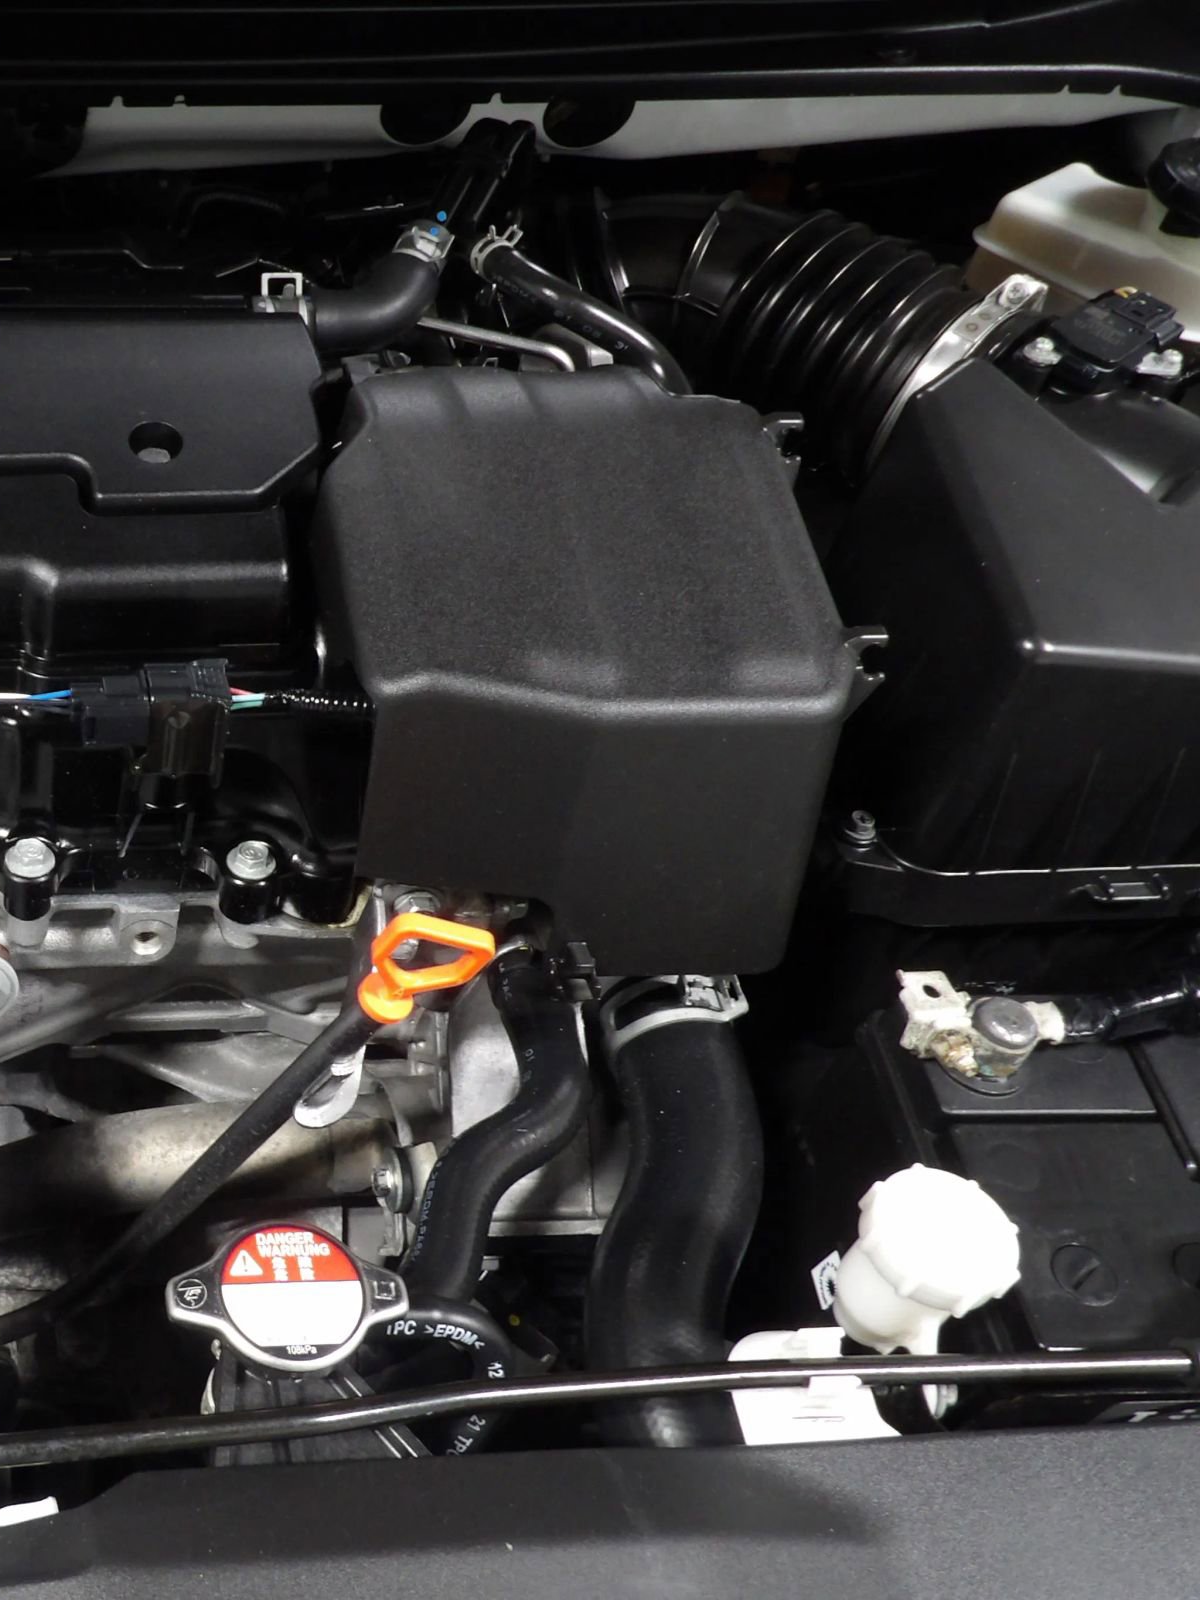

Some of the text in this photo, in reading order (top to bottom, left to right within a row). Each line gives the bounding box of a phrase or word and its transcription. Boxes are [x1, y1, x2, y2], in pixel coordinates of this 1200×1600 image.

[255, 1231, 315, 1246] DANGER
[257, 1243, 331, 1258] WARNUNG
[487, 1361, 506, 1379] 12
[466, 1414, 486, 1432] 21
